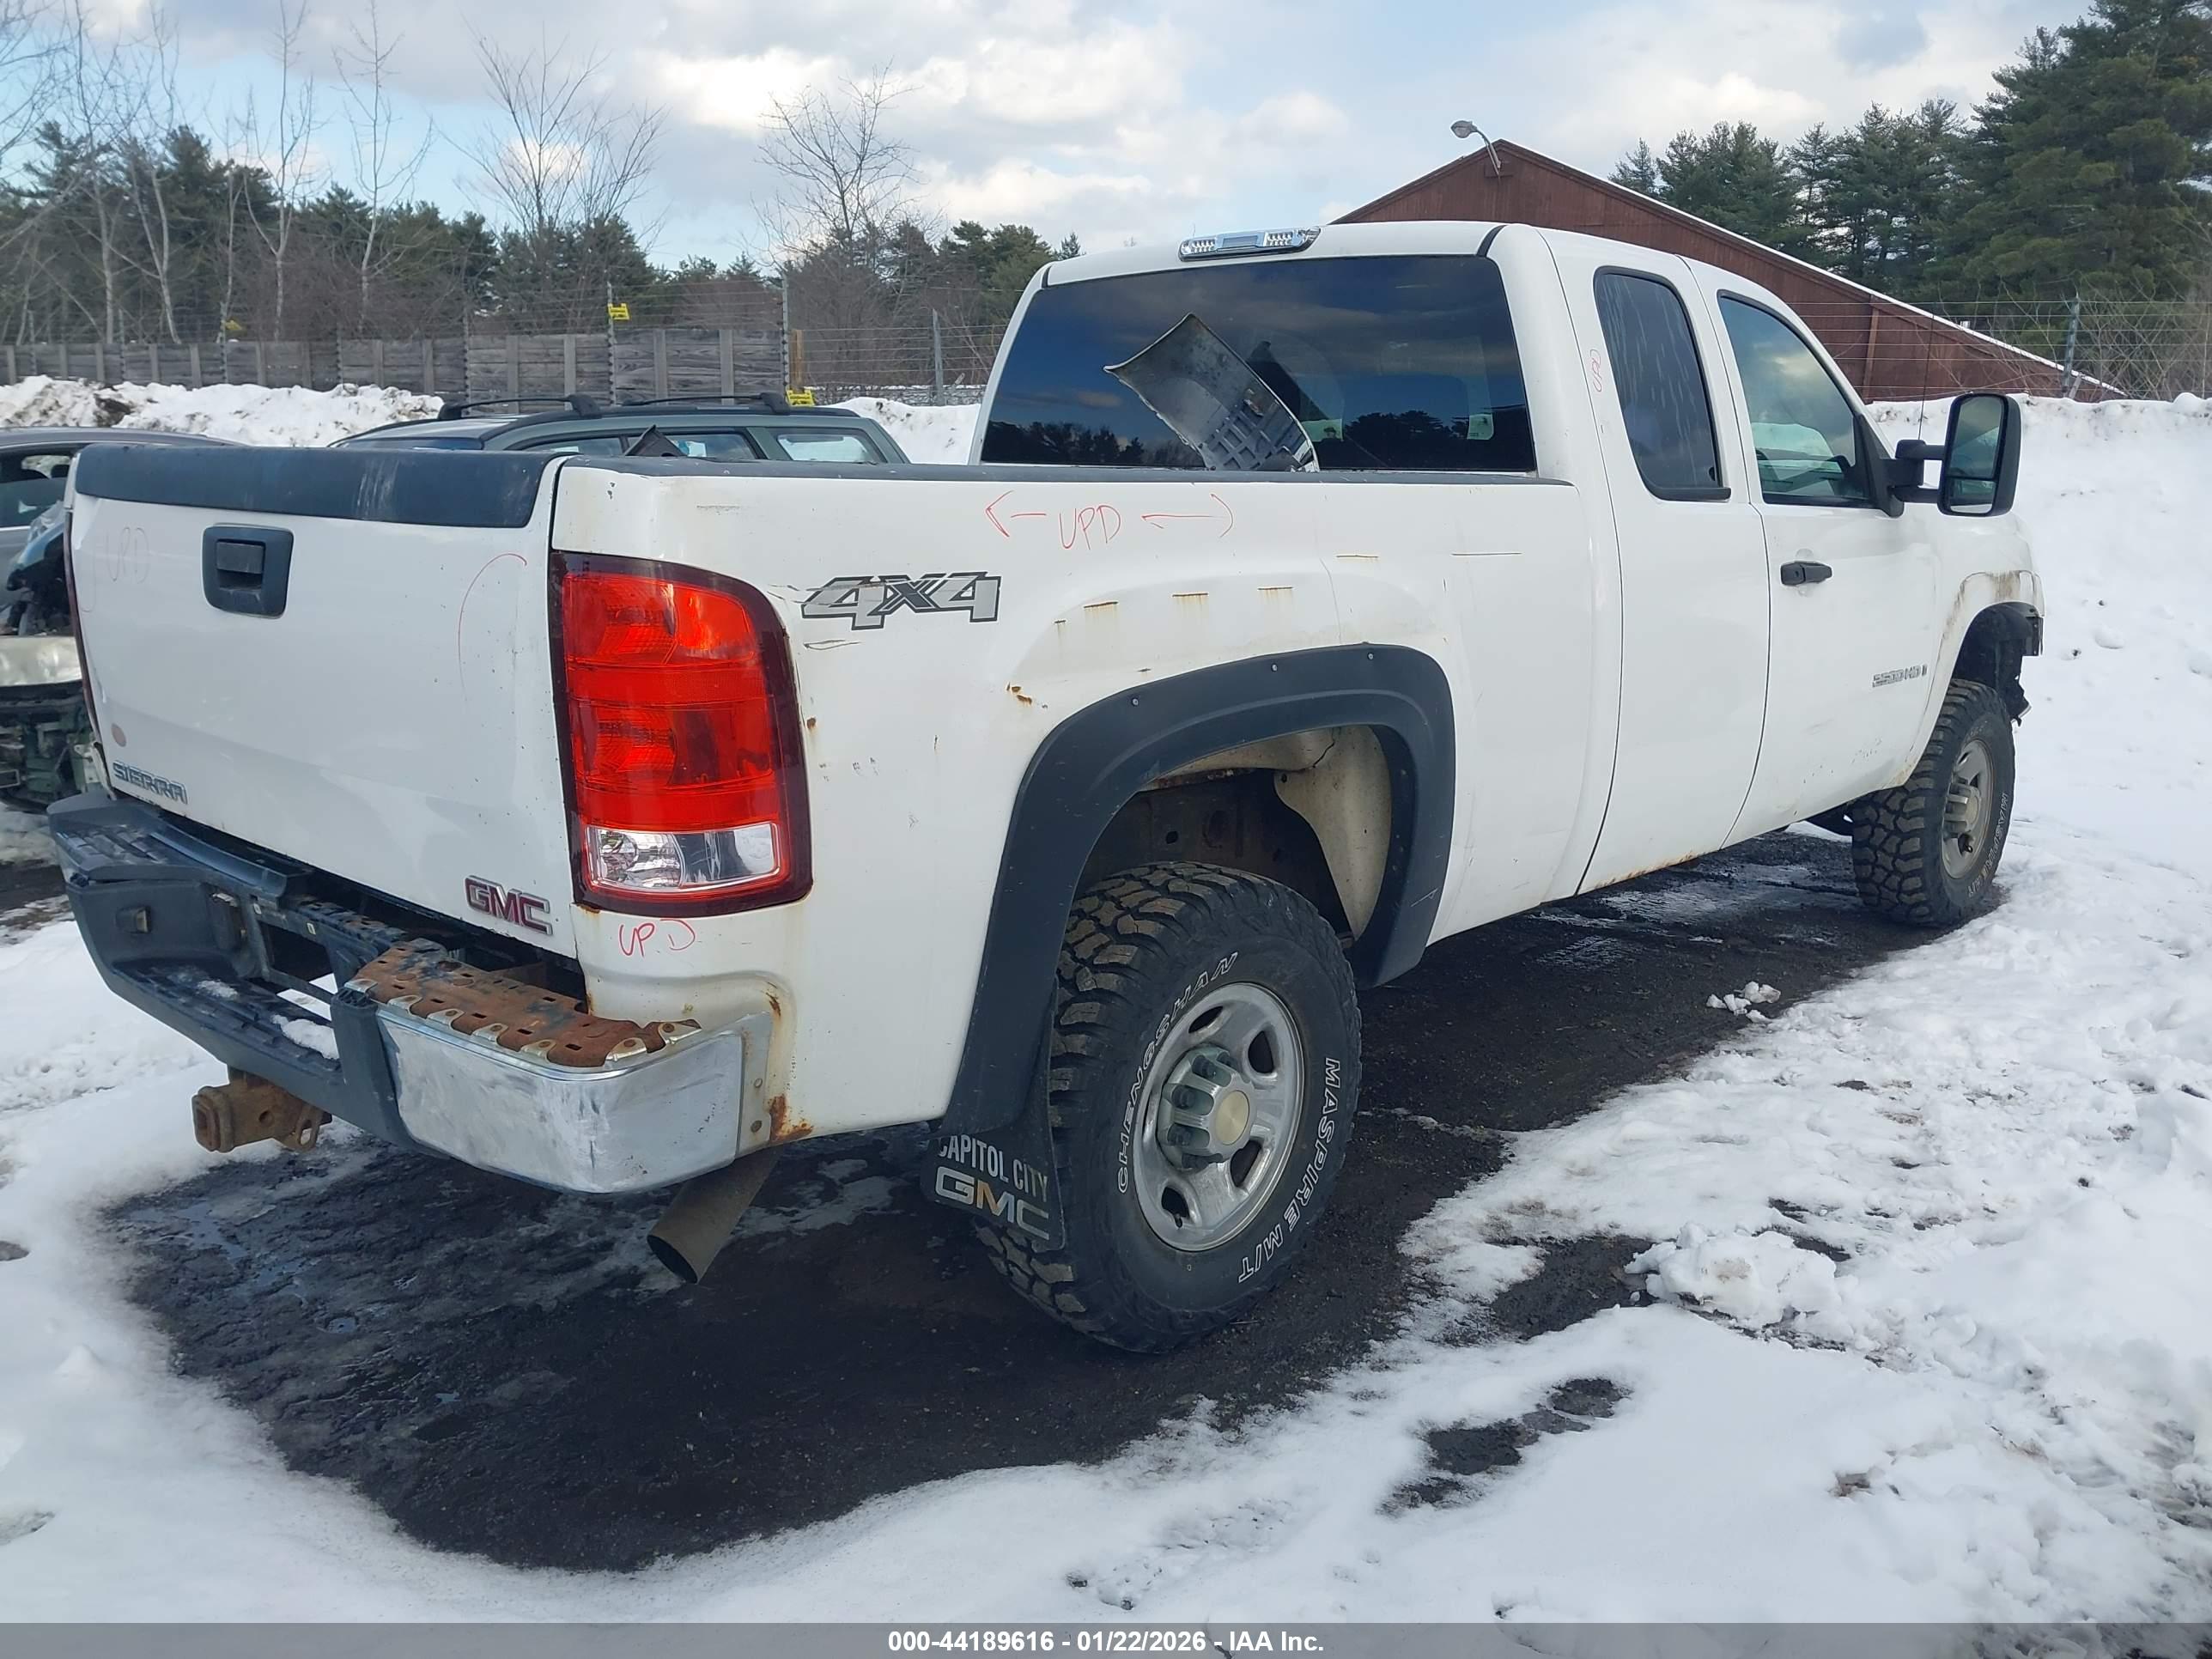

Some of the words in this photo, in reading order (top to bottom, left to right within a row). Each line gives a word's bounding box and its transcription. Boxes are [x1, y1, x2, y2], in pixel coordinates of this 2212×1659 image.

[1059, 504, 1121, 550] UPD
[112, 760, 188, 805] SIERRA
[464, 874, 554, 936] GMC
[1117, 951, 1238, 1194] CHENGSHAN
[1284, 1057, 1340, 1232] MASPIRE
[935, 1165, 1050, 1241] GMC
[1013, 1159, 1048, 1203] CITY
[1238, 1224, 1284, 1284] M/T
